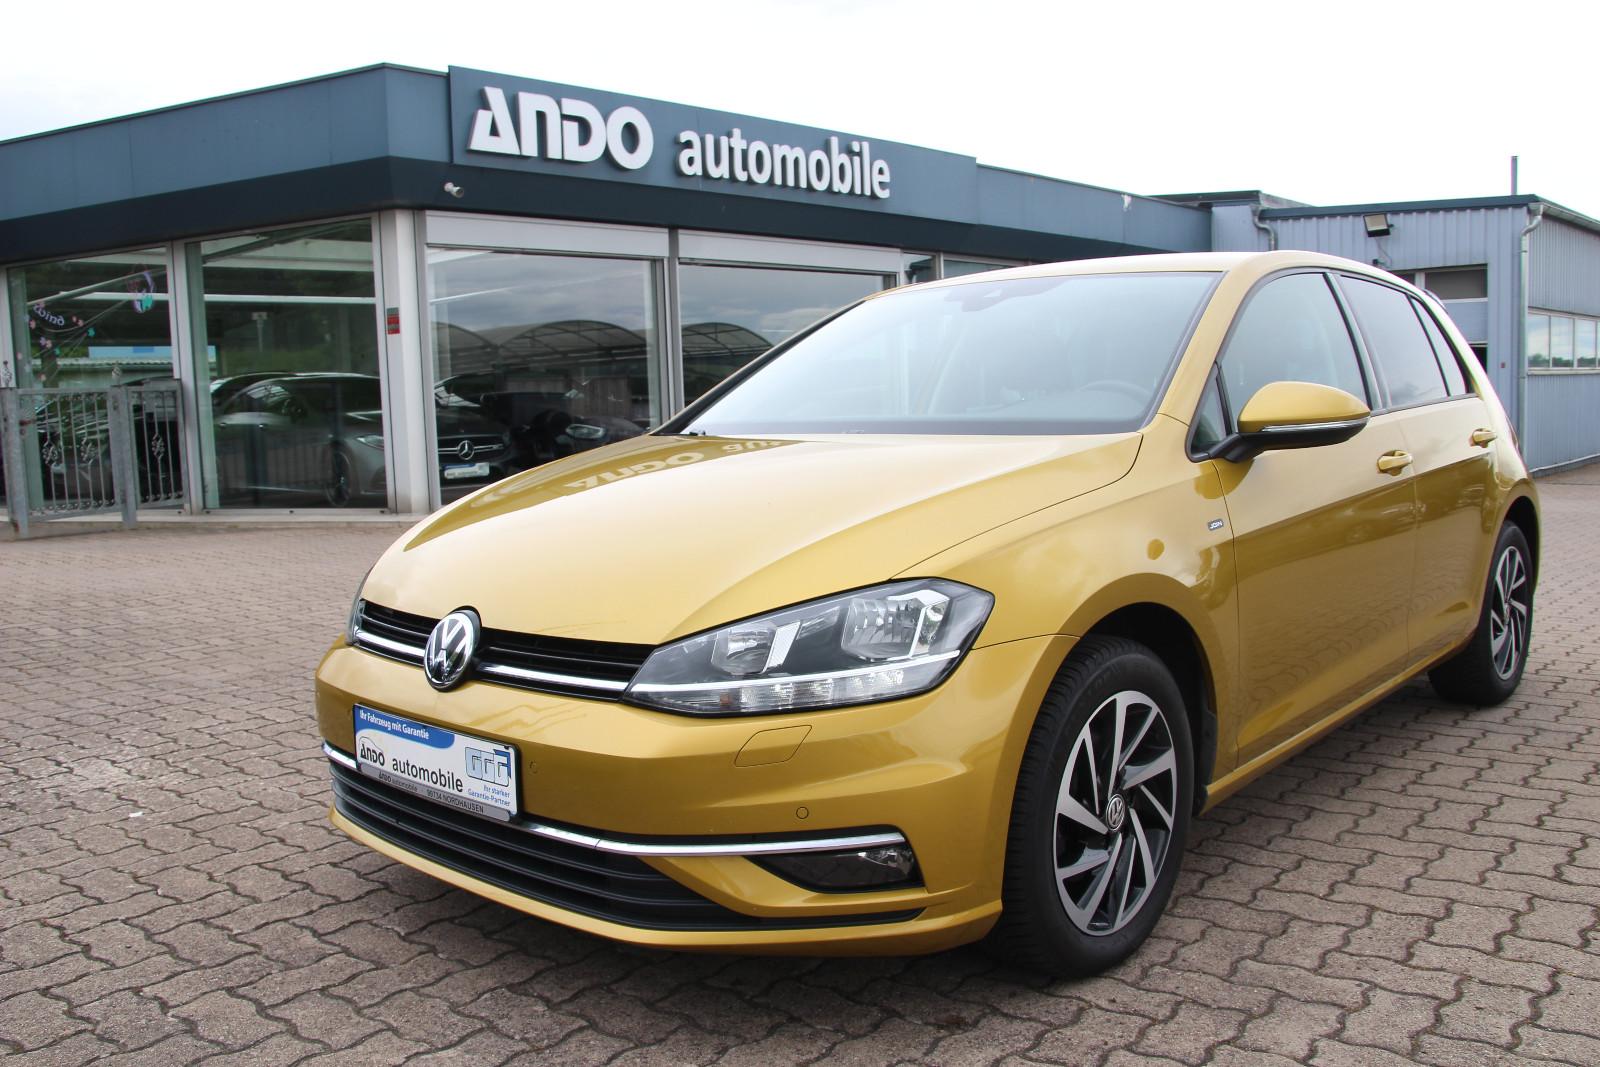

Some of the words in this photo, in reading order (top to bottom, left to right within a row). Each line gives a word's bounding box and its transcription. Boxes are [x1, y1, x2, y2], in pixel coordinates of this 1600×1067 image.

[467, 86, 655, 170] ANDO
[675, 128, 891, 199] automobile
[359, 709, 367, 720] Ihr
[367, 712, 392, 731] Fahrzeug
[392, 721, 402, 732] mit
[402, 724, 430, 740] Garantie
[360, 743, 385, 767] ANDO
[392, 757, 464, 793] automobile
[442, 792, 485, 814] NORDHAUSEN
